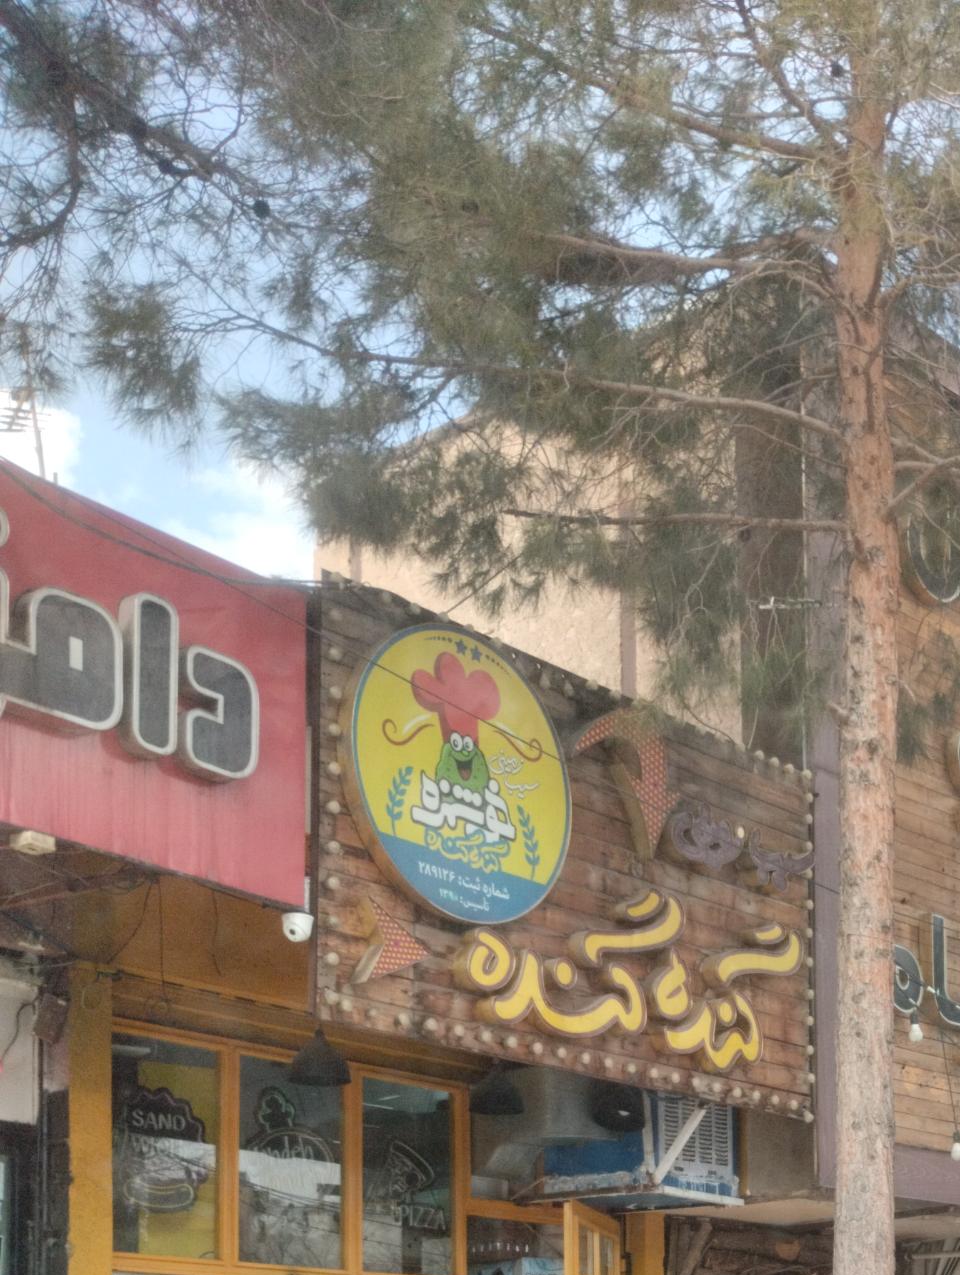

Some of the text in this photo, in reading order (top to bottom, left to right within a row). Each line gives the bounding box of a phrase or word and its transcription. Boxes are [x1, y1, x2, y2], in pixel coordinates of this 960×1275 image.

[0, 505, 259, 780] دام
[411, 769, 516, 842] خوشمزه
[483, 882, 511, 900] شماره
[132, 1108, 186, 1131] SAND
[400, 1204, 446, 1231] PIZZA
